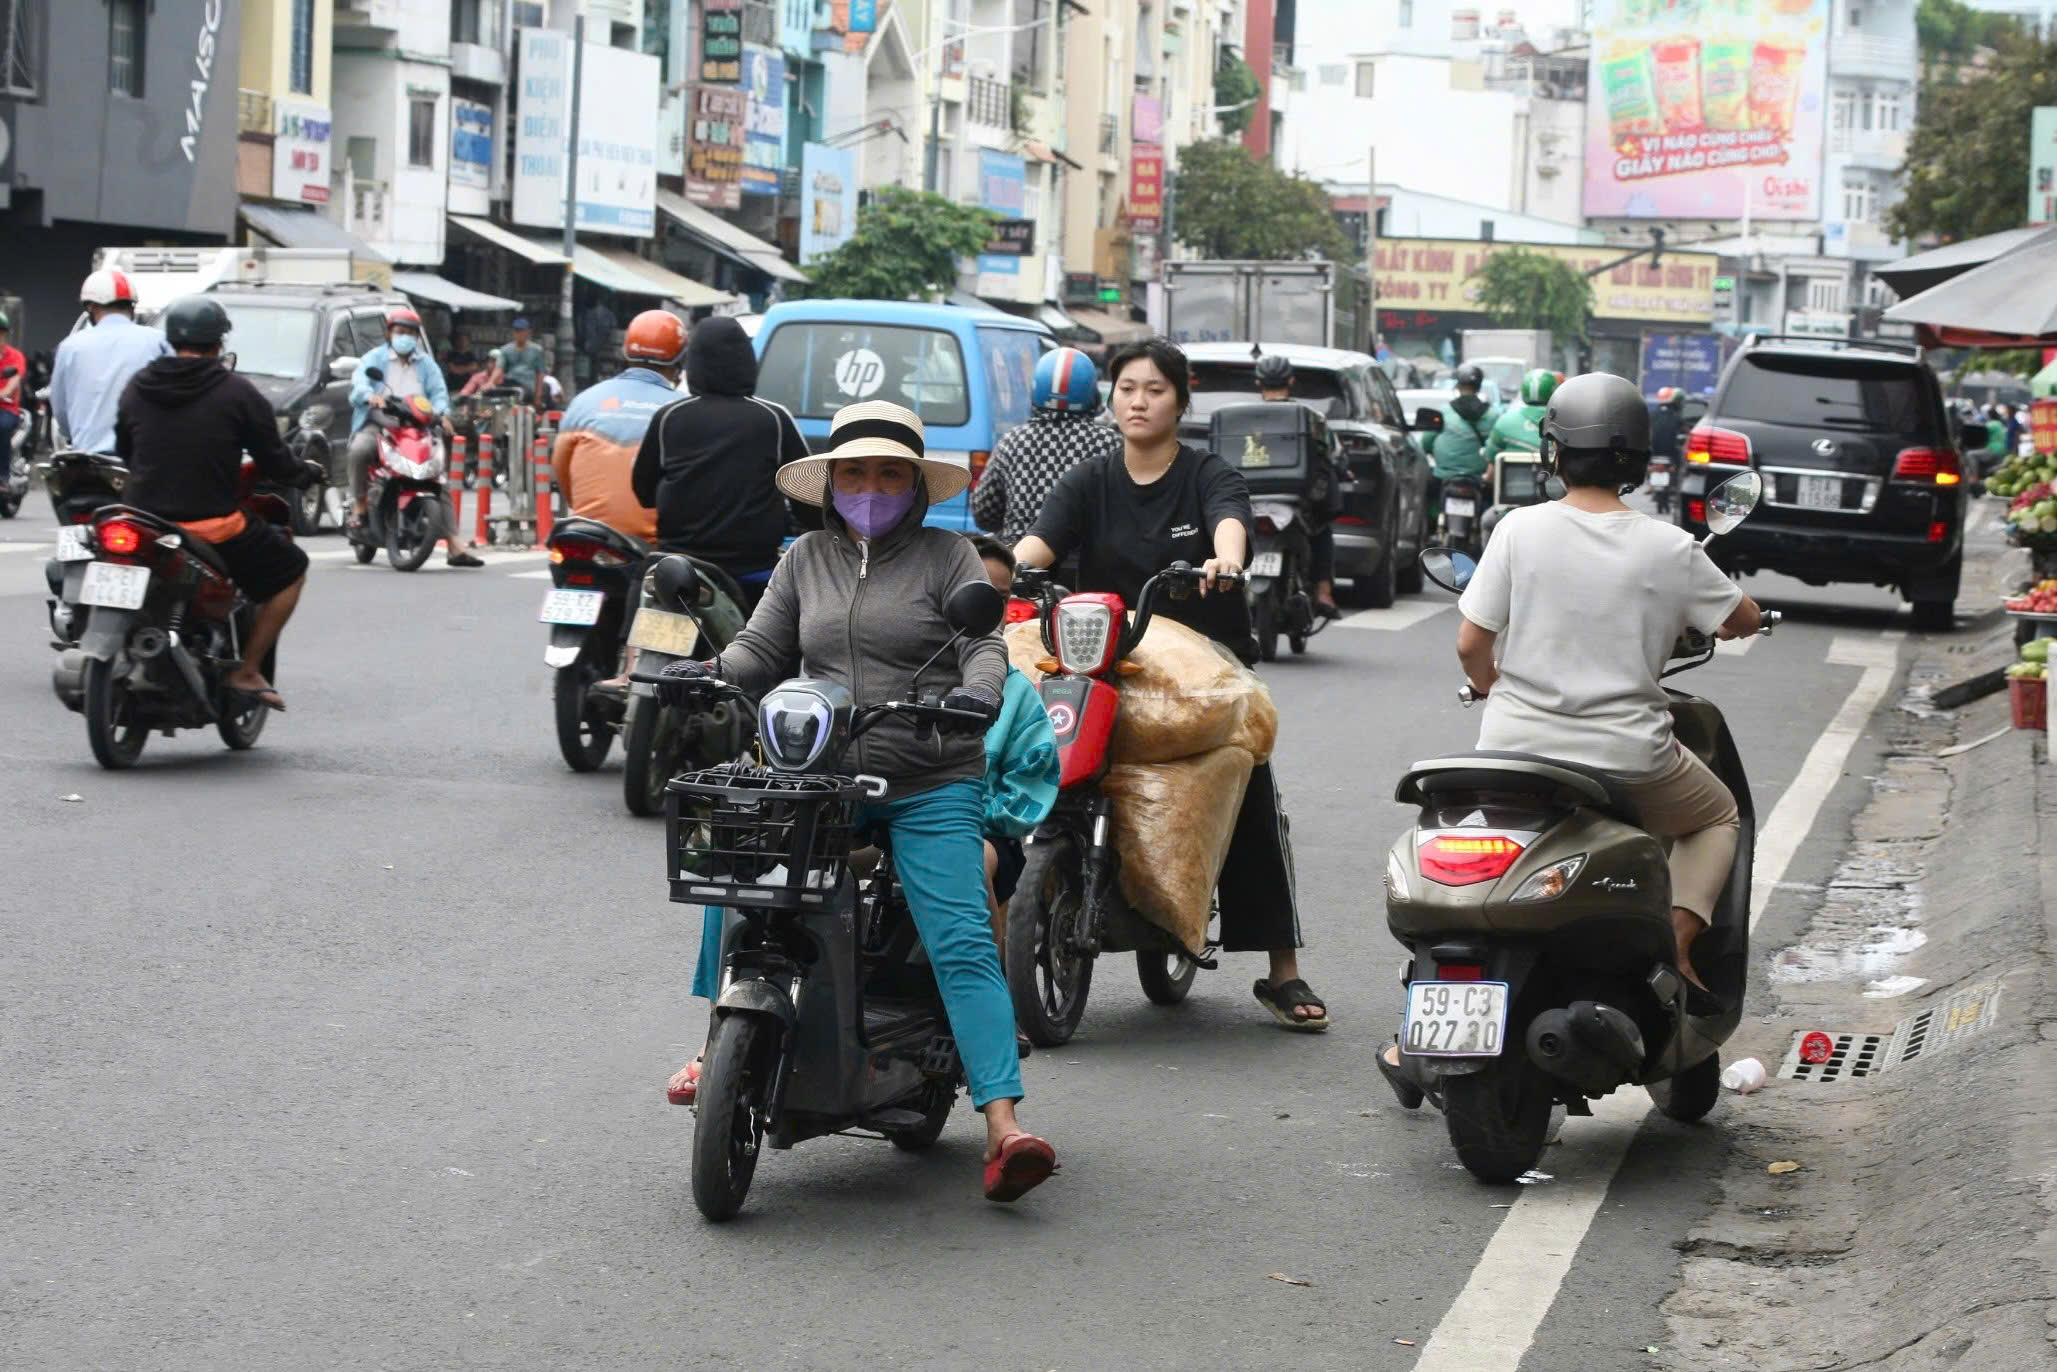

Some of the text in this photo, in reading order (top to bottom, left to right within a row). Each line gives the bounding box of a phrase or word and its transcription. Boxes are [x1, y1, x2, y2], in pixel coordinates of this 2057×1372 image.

[841, 350, 879, 397] hp
[1171, 524, 1191, 533] YOU'RE
[1172, 528, 1199, 539] DIFFERENT
[1422, 987, 1493, 1016] 59-C3
